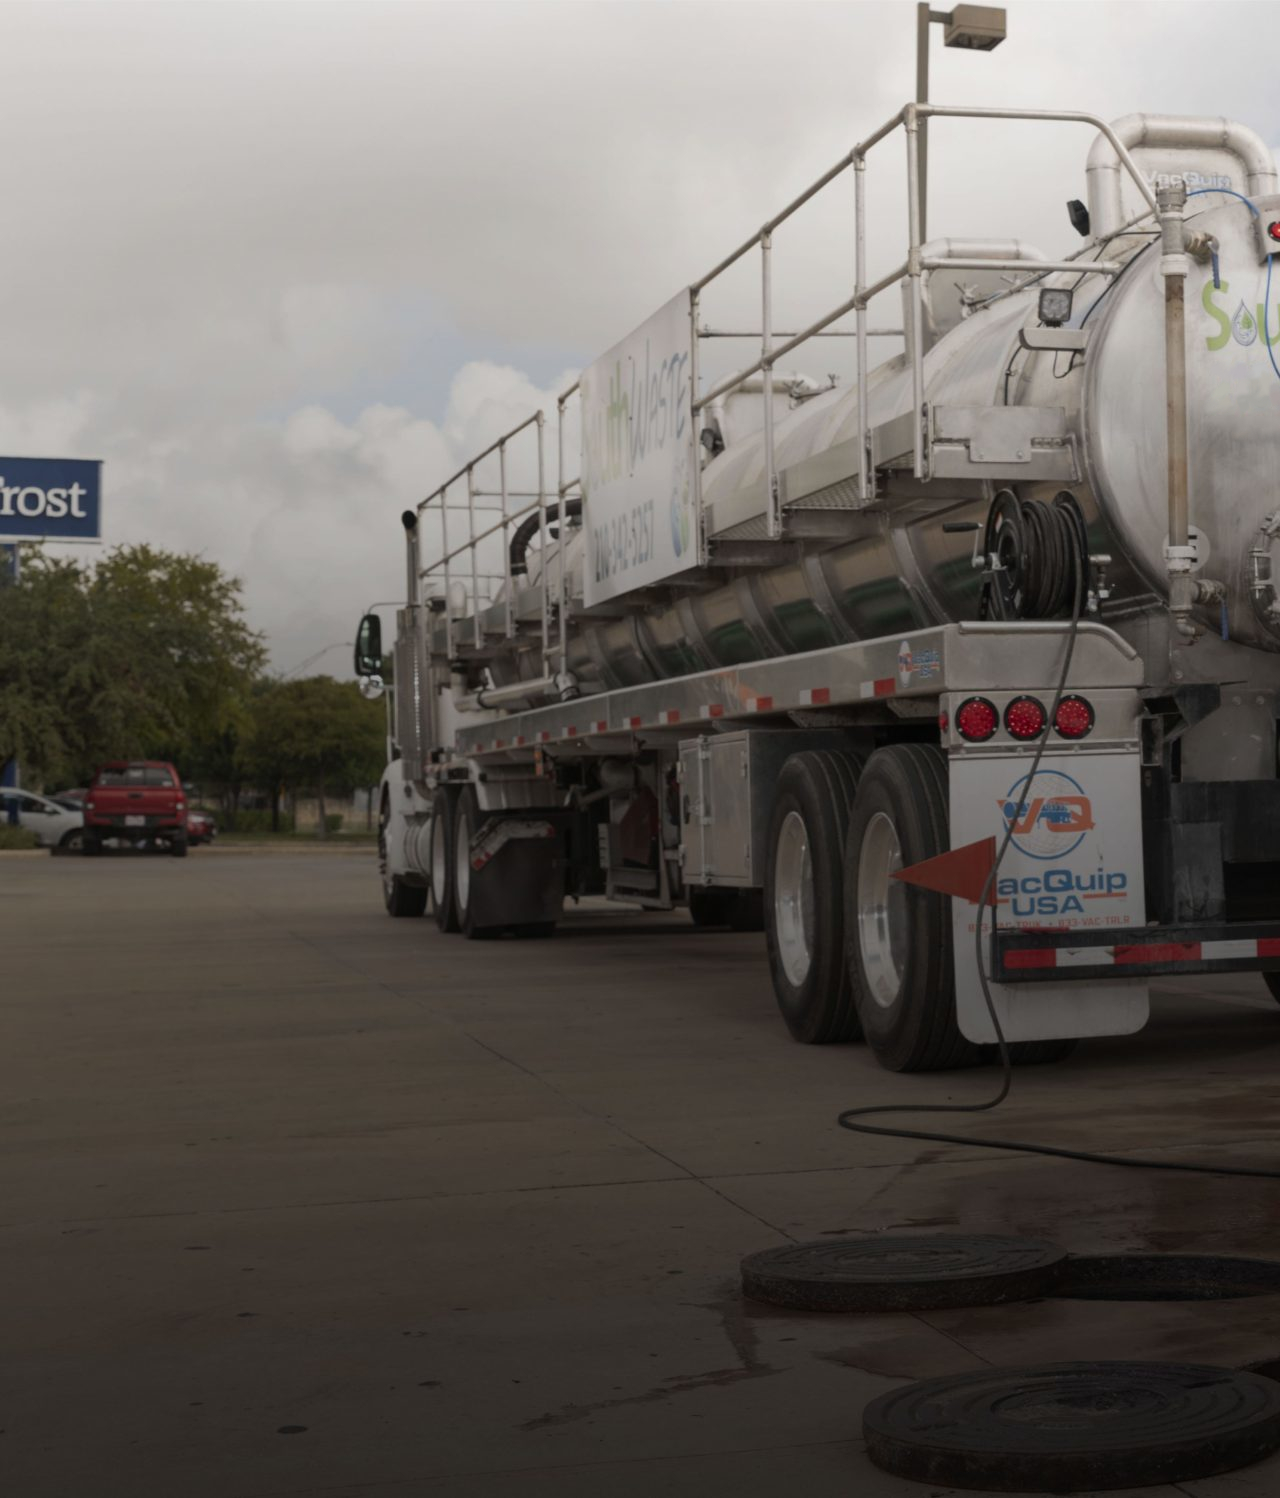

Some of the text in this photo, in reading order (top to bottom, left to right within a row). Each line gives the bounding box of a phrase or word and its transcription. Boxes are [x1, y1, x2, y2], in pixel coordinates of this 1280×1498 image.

[0, 475, 87, 518] rost
[998, 868, 1127, 895] acQuip
[1012, 895, 1084, 916] USA
